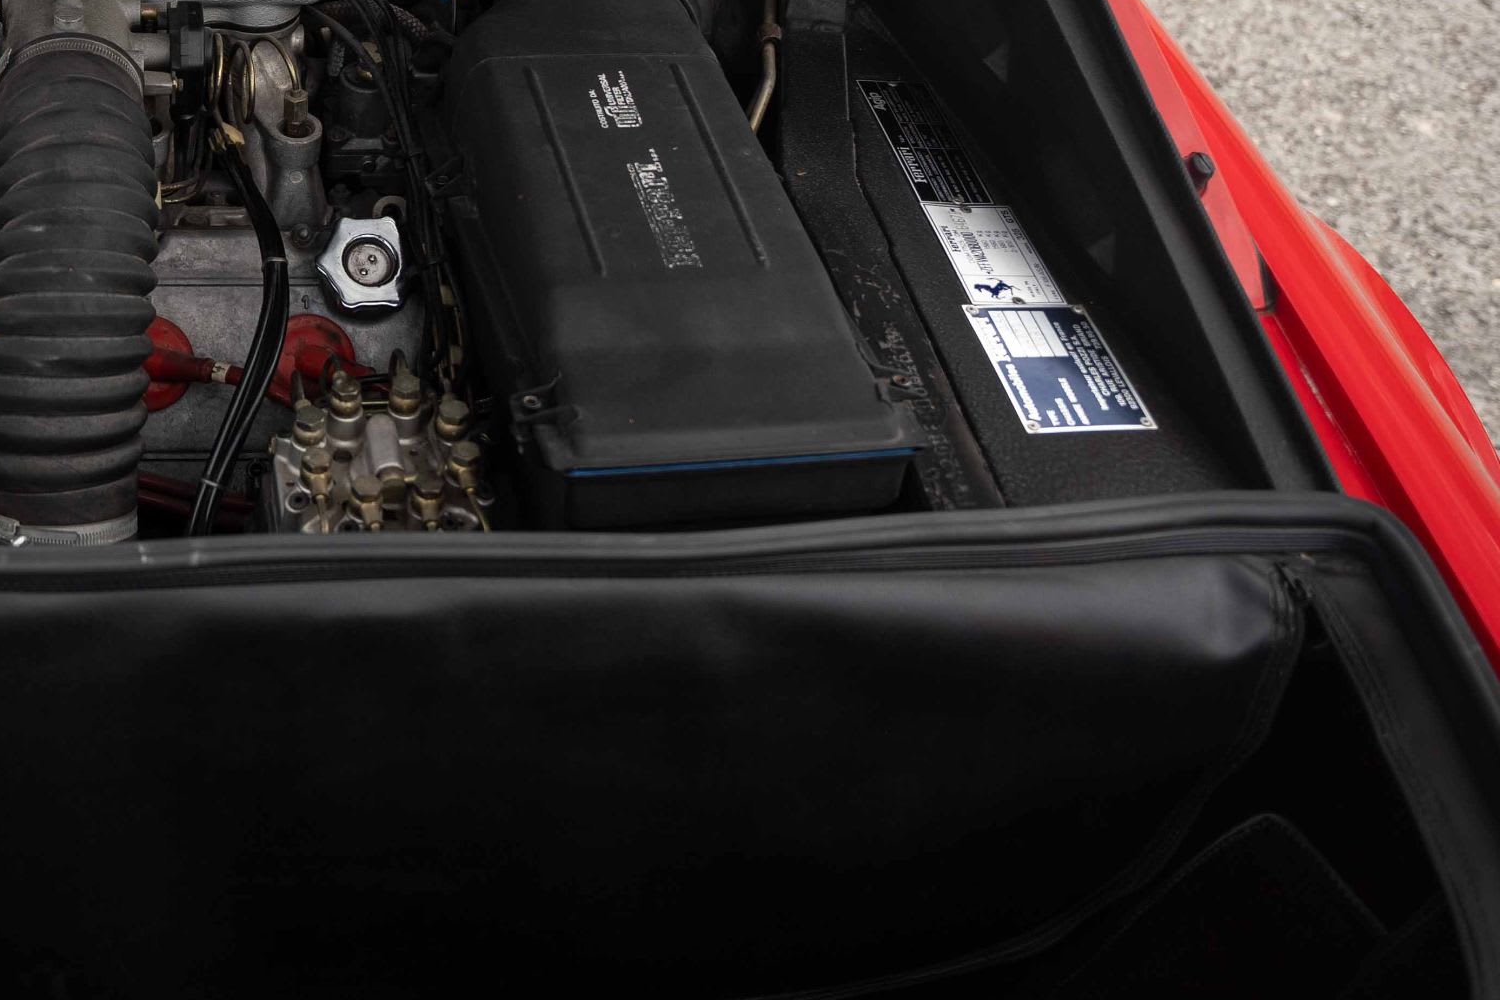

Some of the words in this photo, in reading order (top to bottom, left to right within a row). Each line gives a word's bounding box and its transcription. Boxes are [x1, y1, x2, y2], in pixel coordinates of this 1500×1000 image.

[612, 87, 626, 105] FILTER
[865, 91, 890, 110] Agip
[895, 146, 928, 183] Ferrari
[999, 210, 1015, 222] GTS
[938, 225, 962, 252] Ferrari
[301, 295, 309, 309] 1
[1051, 321, 1068, 340] France
[1070, 324, 1091, 346] BRIAND
[1076, 346, 1093, 365] POZZI
[1086, 349, 1109, 376] ARISTIDE
[1087, 366, 1111, 395] CHARLES
[1100, 355, 1125, 387] LEVALLOIS
[1104, 378, 1118, 391] RUE
